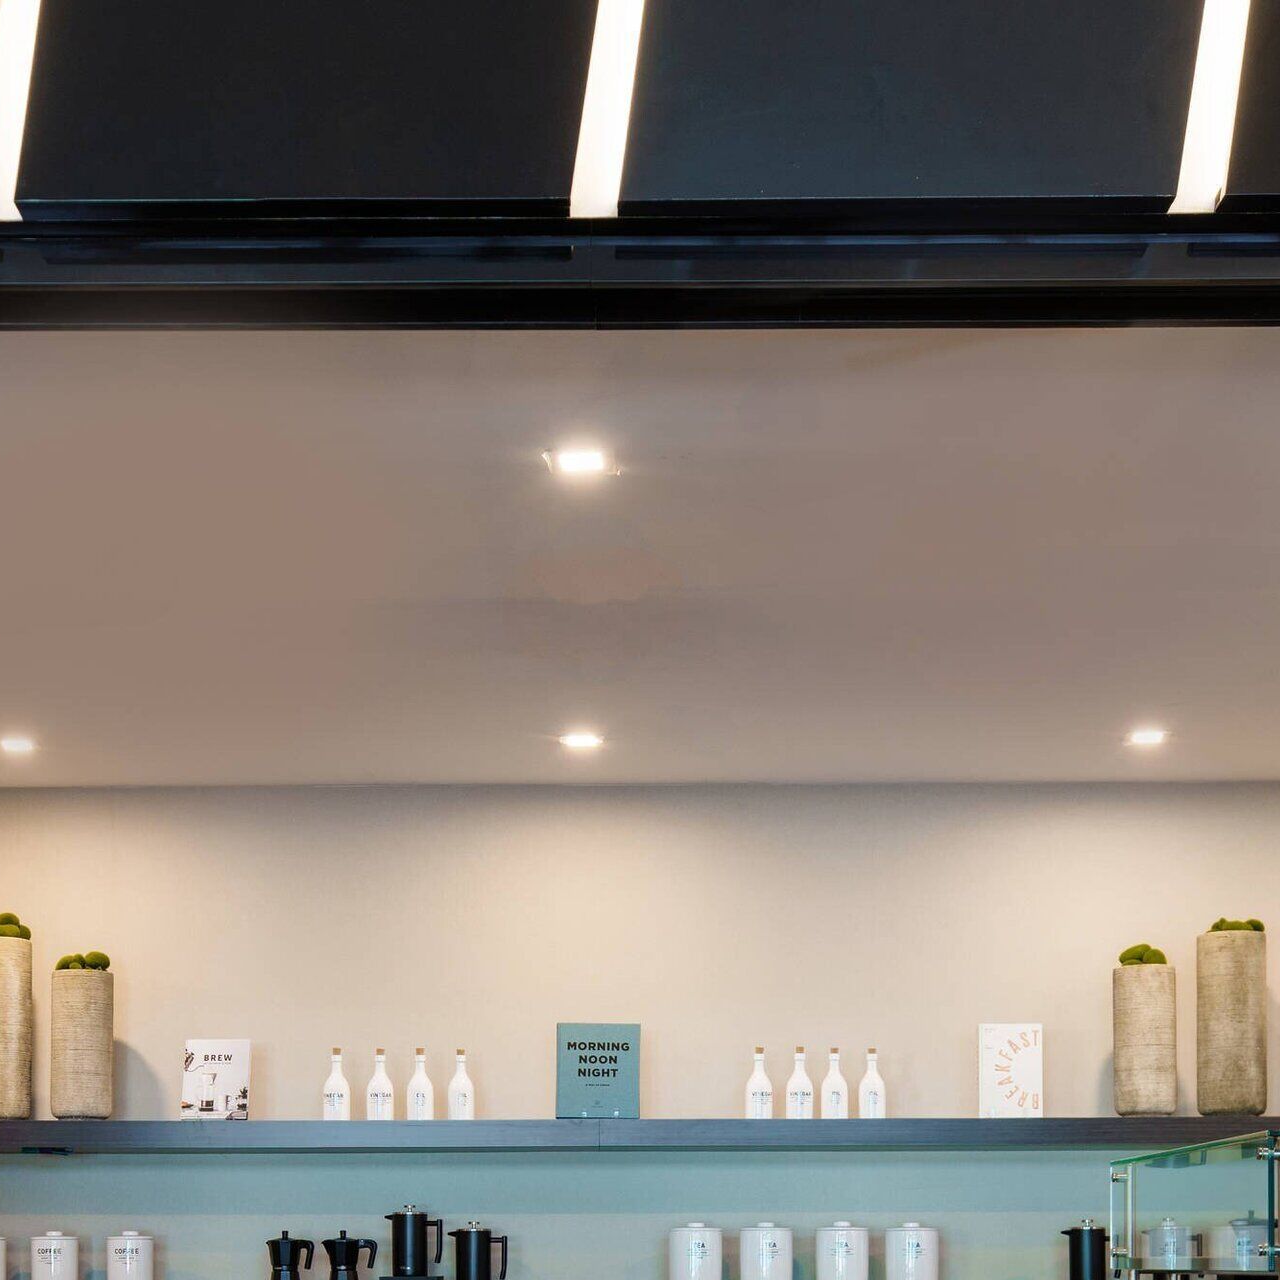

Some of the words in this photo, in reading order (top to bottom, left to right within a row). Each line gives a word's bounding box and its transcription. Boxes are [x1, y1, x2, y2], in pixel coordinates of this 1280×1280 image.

[567, 1042, 630, 1051] MORNING
[579, 1055, 618, 1064] NOON
[577, 1068, 619, 1077] NIGHT
[994, 1030, 1039, 1109] BREAKFAST
